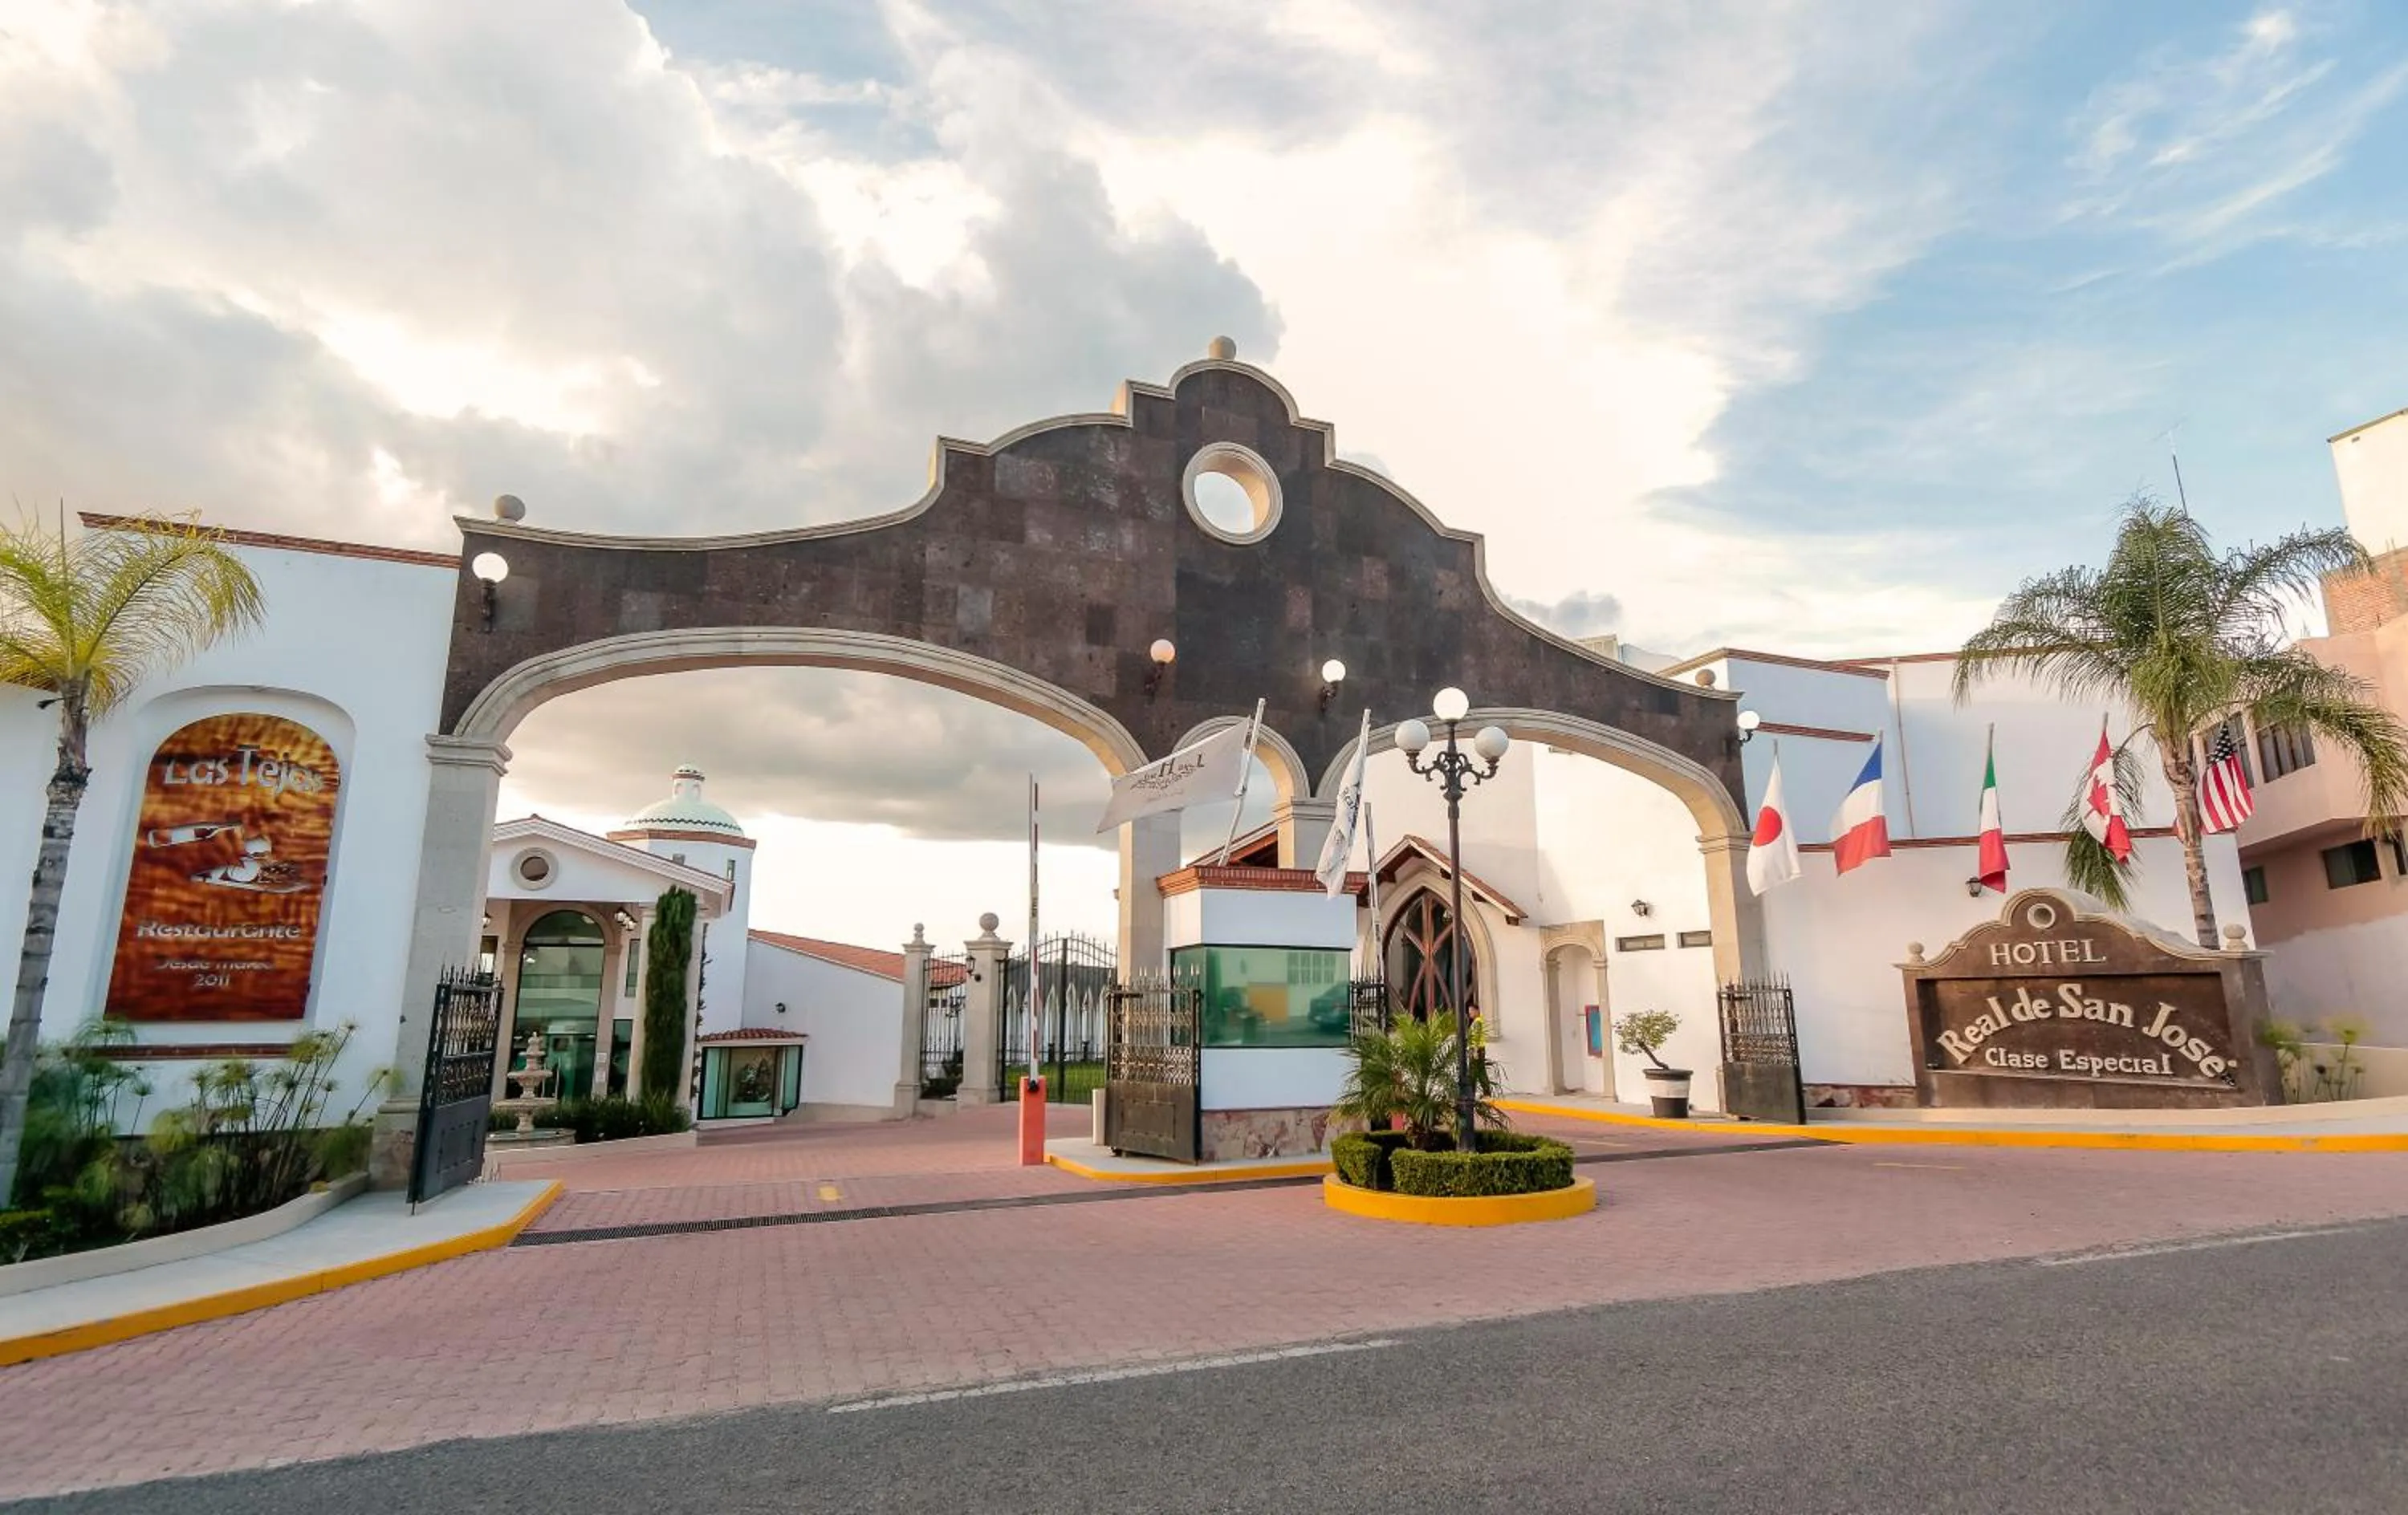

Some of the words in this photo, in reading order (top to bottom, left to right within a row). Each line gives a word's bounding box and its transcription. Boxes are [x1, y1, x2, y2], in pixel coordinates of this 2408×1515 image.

[164, 757, 230, 786] Las
[237, 745, 323, 795] Tejas
[137, 922, 302, 938] Restaurante
[1989, 938, 2107, 965] HOTEL
[194, 973, 231, 987] 2011
[1935, 996, 2012, 1065] Real
[2011, 987, 2052, 1022] de
[2057, 983, 2134, 1028] San
[1985, 1046, 2049, 1069] Clase
[2059, 1049, 2174, 1078] Especial
